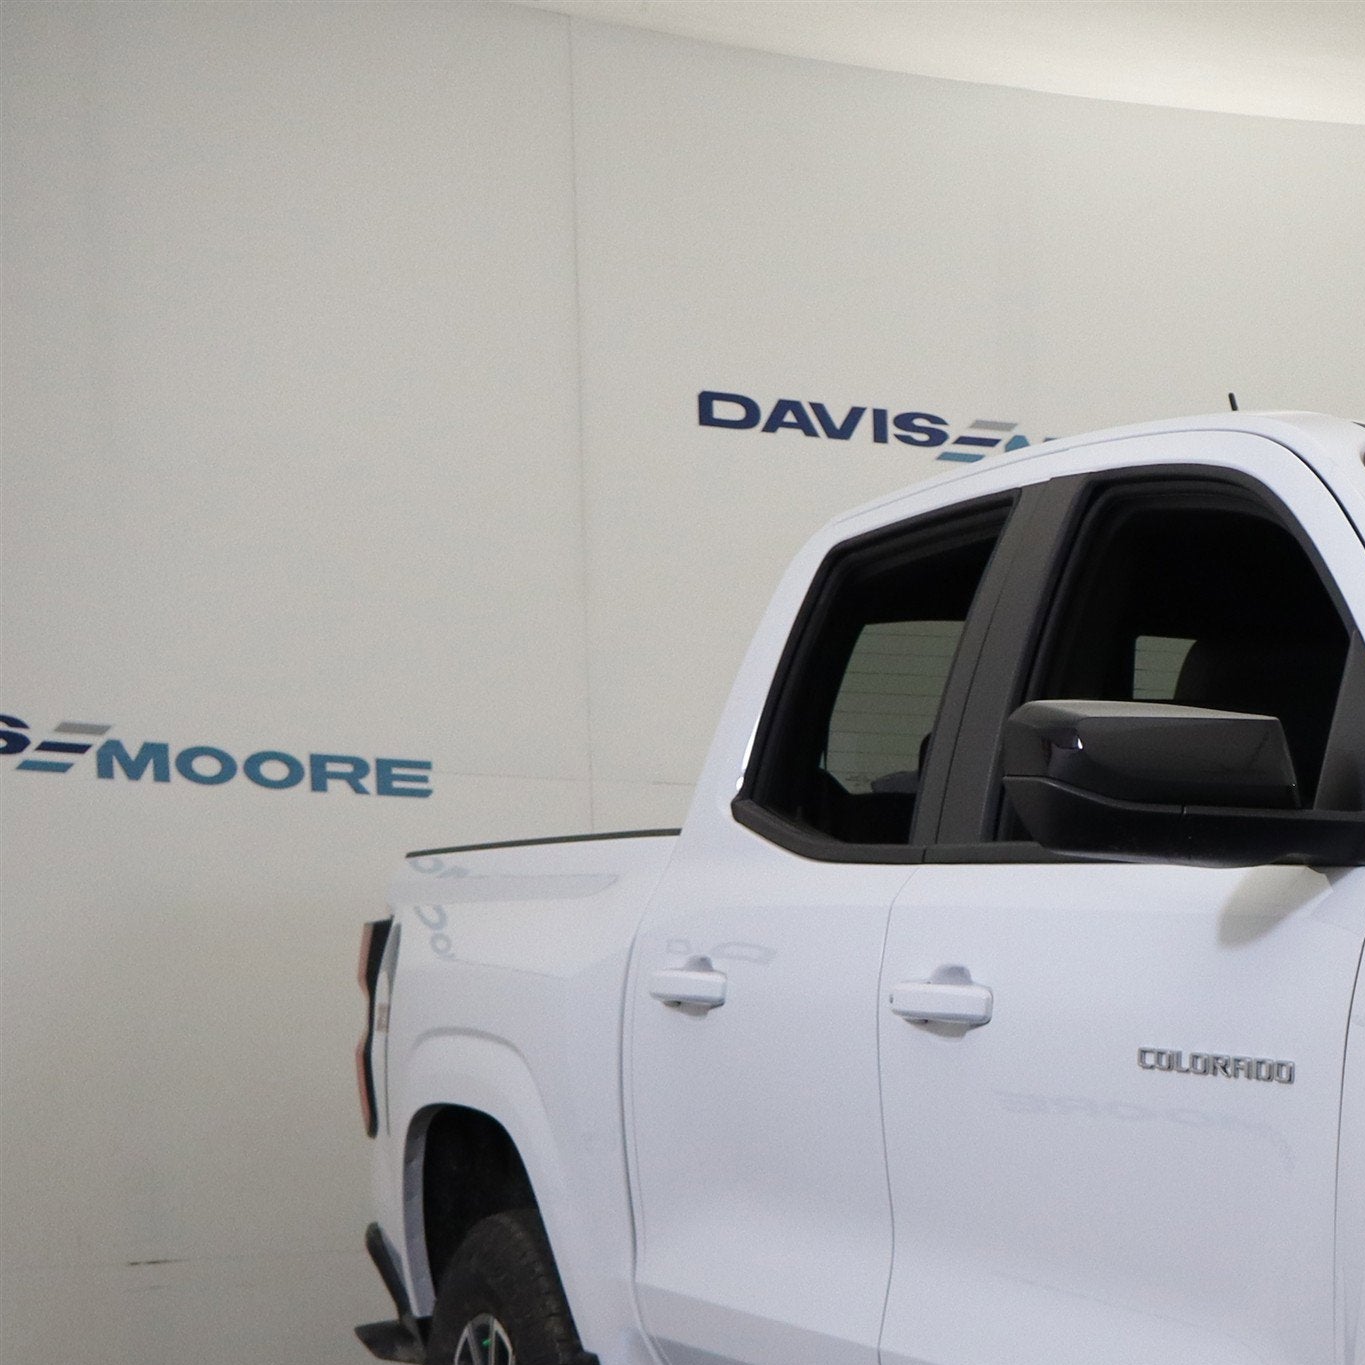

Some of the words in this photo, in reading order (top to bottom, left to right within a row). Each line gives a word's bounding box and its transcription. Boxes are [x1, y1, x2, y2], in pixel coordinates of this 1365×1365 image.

[697, 390, 950, 448] DAVIS
[96, 739, 434, 798] MOORE
[1137, 1046, 1295, 1084] COLORADO
